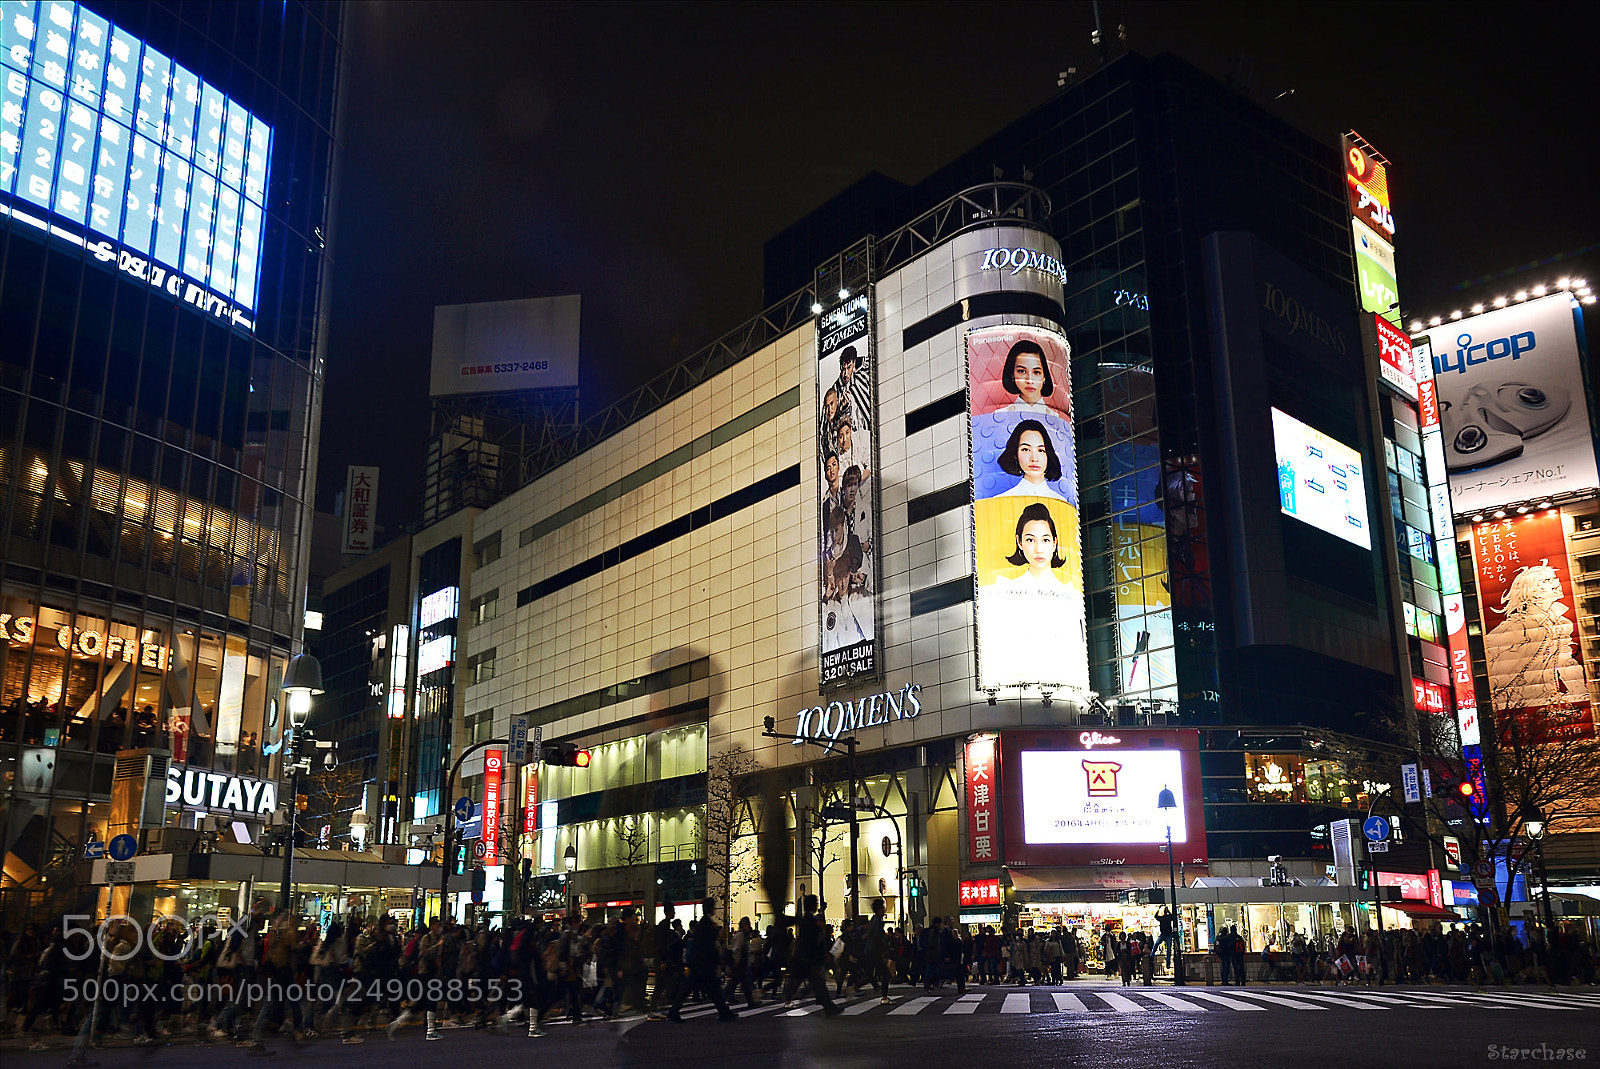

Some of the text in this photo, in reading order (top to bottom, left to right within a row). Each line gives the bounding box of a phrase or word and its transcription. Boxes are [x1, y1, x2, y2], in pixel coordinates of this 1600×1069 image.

[1362, 270, 1398, 307] レイク
[973, 335, 1014, 345] Panasonic
[494, 361, 548, 373] 5337-2468
[351, 472, 371, 534] 大和証券
[57, 625, 174, 671] COFFEE
[824, 645, 873, 668] NEW ALBUM
[850, 658, 873, 673] SALE
[1453, 649, 1470, 683] アコム
